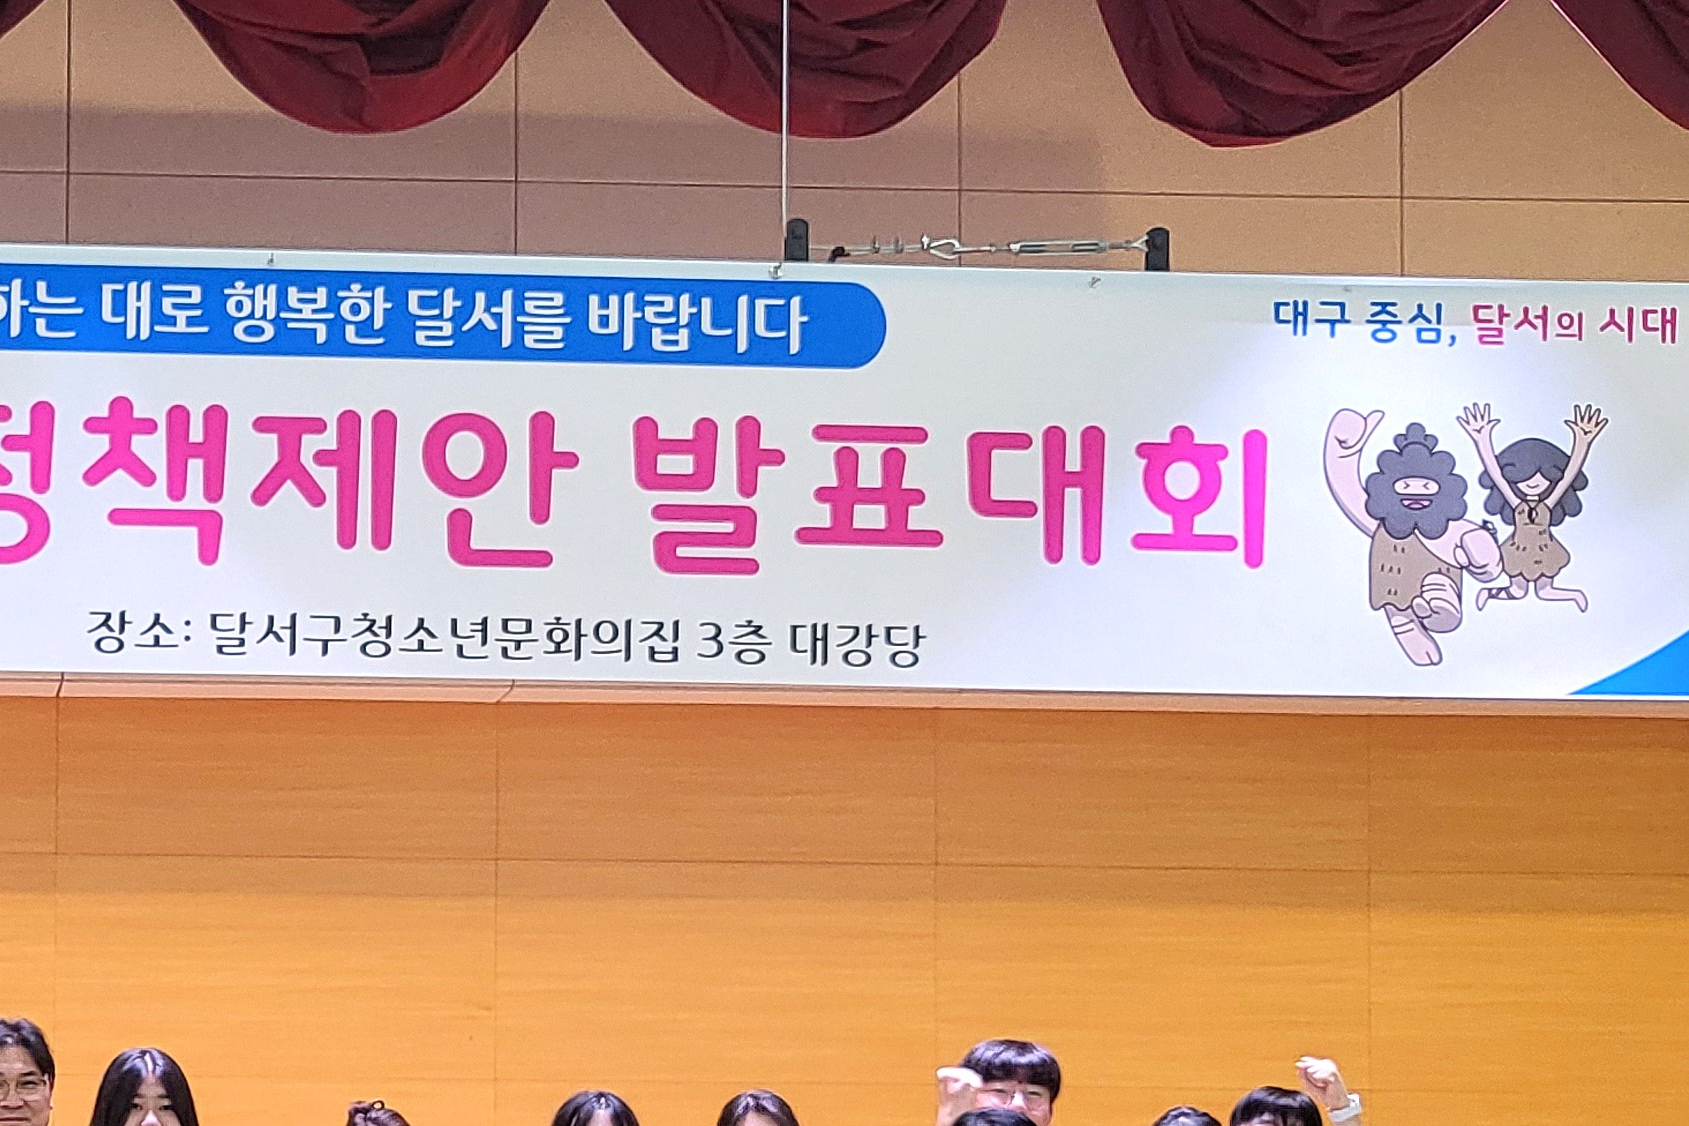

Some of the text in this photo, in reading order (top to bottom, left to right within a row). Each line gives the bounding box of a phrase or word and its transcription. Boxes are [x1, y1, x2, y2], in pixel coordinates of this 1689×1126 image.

[100, 279, 210, 342] 대로
[222, 281, 394, 347] 행복한
[406, 287, 572, 351] 달서를
[587, 291, 809, 357] 바랍니다
[1274, 300, 1679, 352] 대구 중심, 달서의 시대
[633, 415, 1268, 576] 발표대회
[87, 610, 927, 668] 장소: 달서구청소년문화의집 3층 대강당
